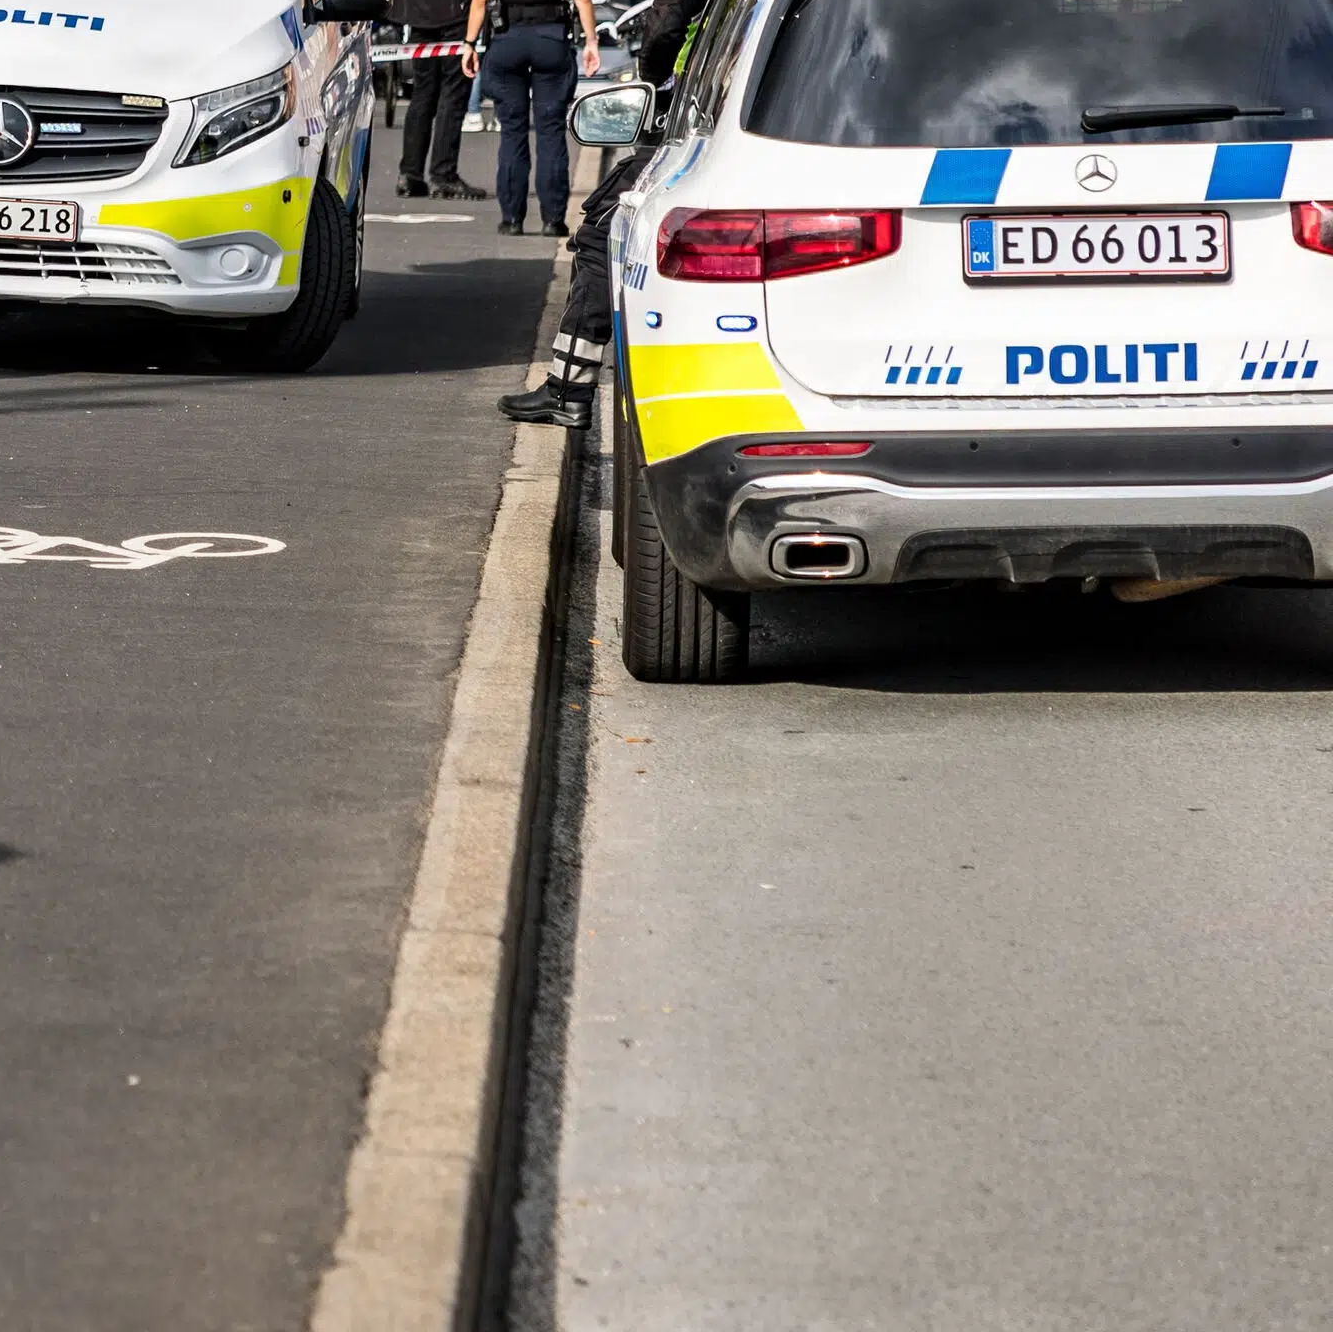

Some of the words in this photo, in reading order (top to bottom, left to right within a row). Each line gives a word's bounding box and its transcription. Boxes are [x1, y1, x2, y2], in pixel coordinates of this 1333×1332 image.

[20, 207, 71, 234] 218
[972, 251, 991, 264] DK
[1001, 226, 1058, 264] ED
[1072, 224, 1124, 264] 66
[1138, 224, 1219, 263] 013
[1005, 343, 1198, 385] POLITI
